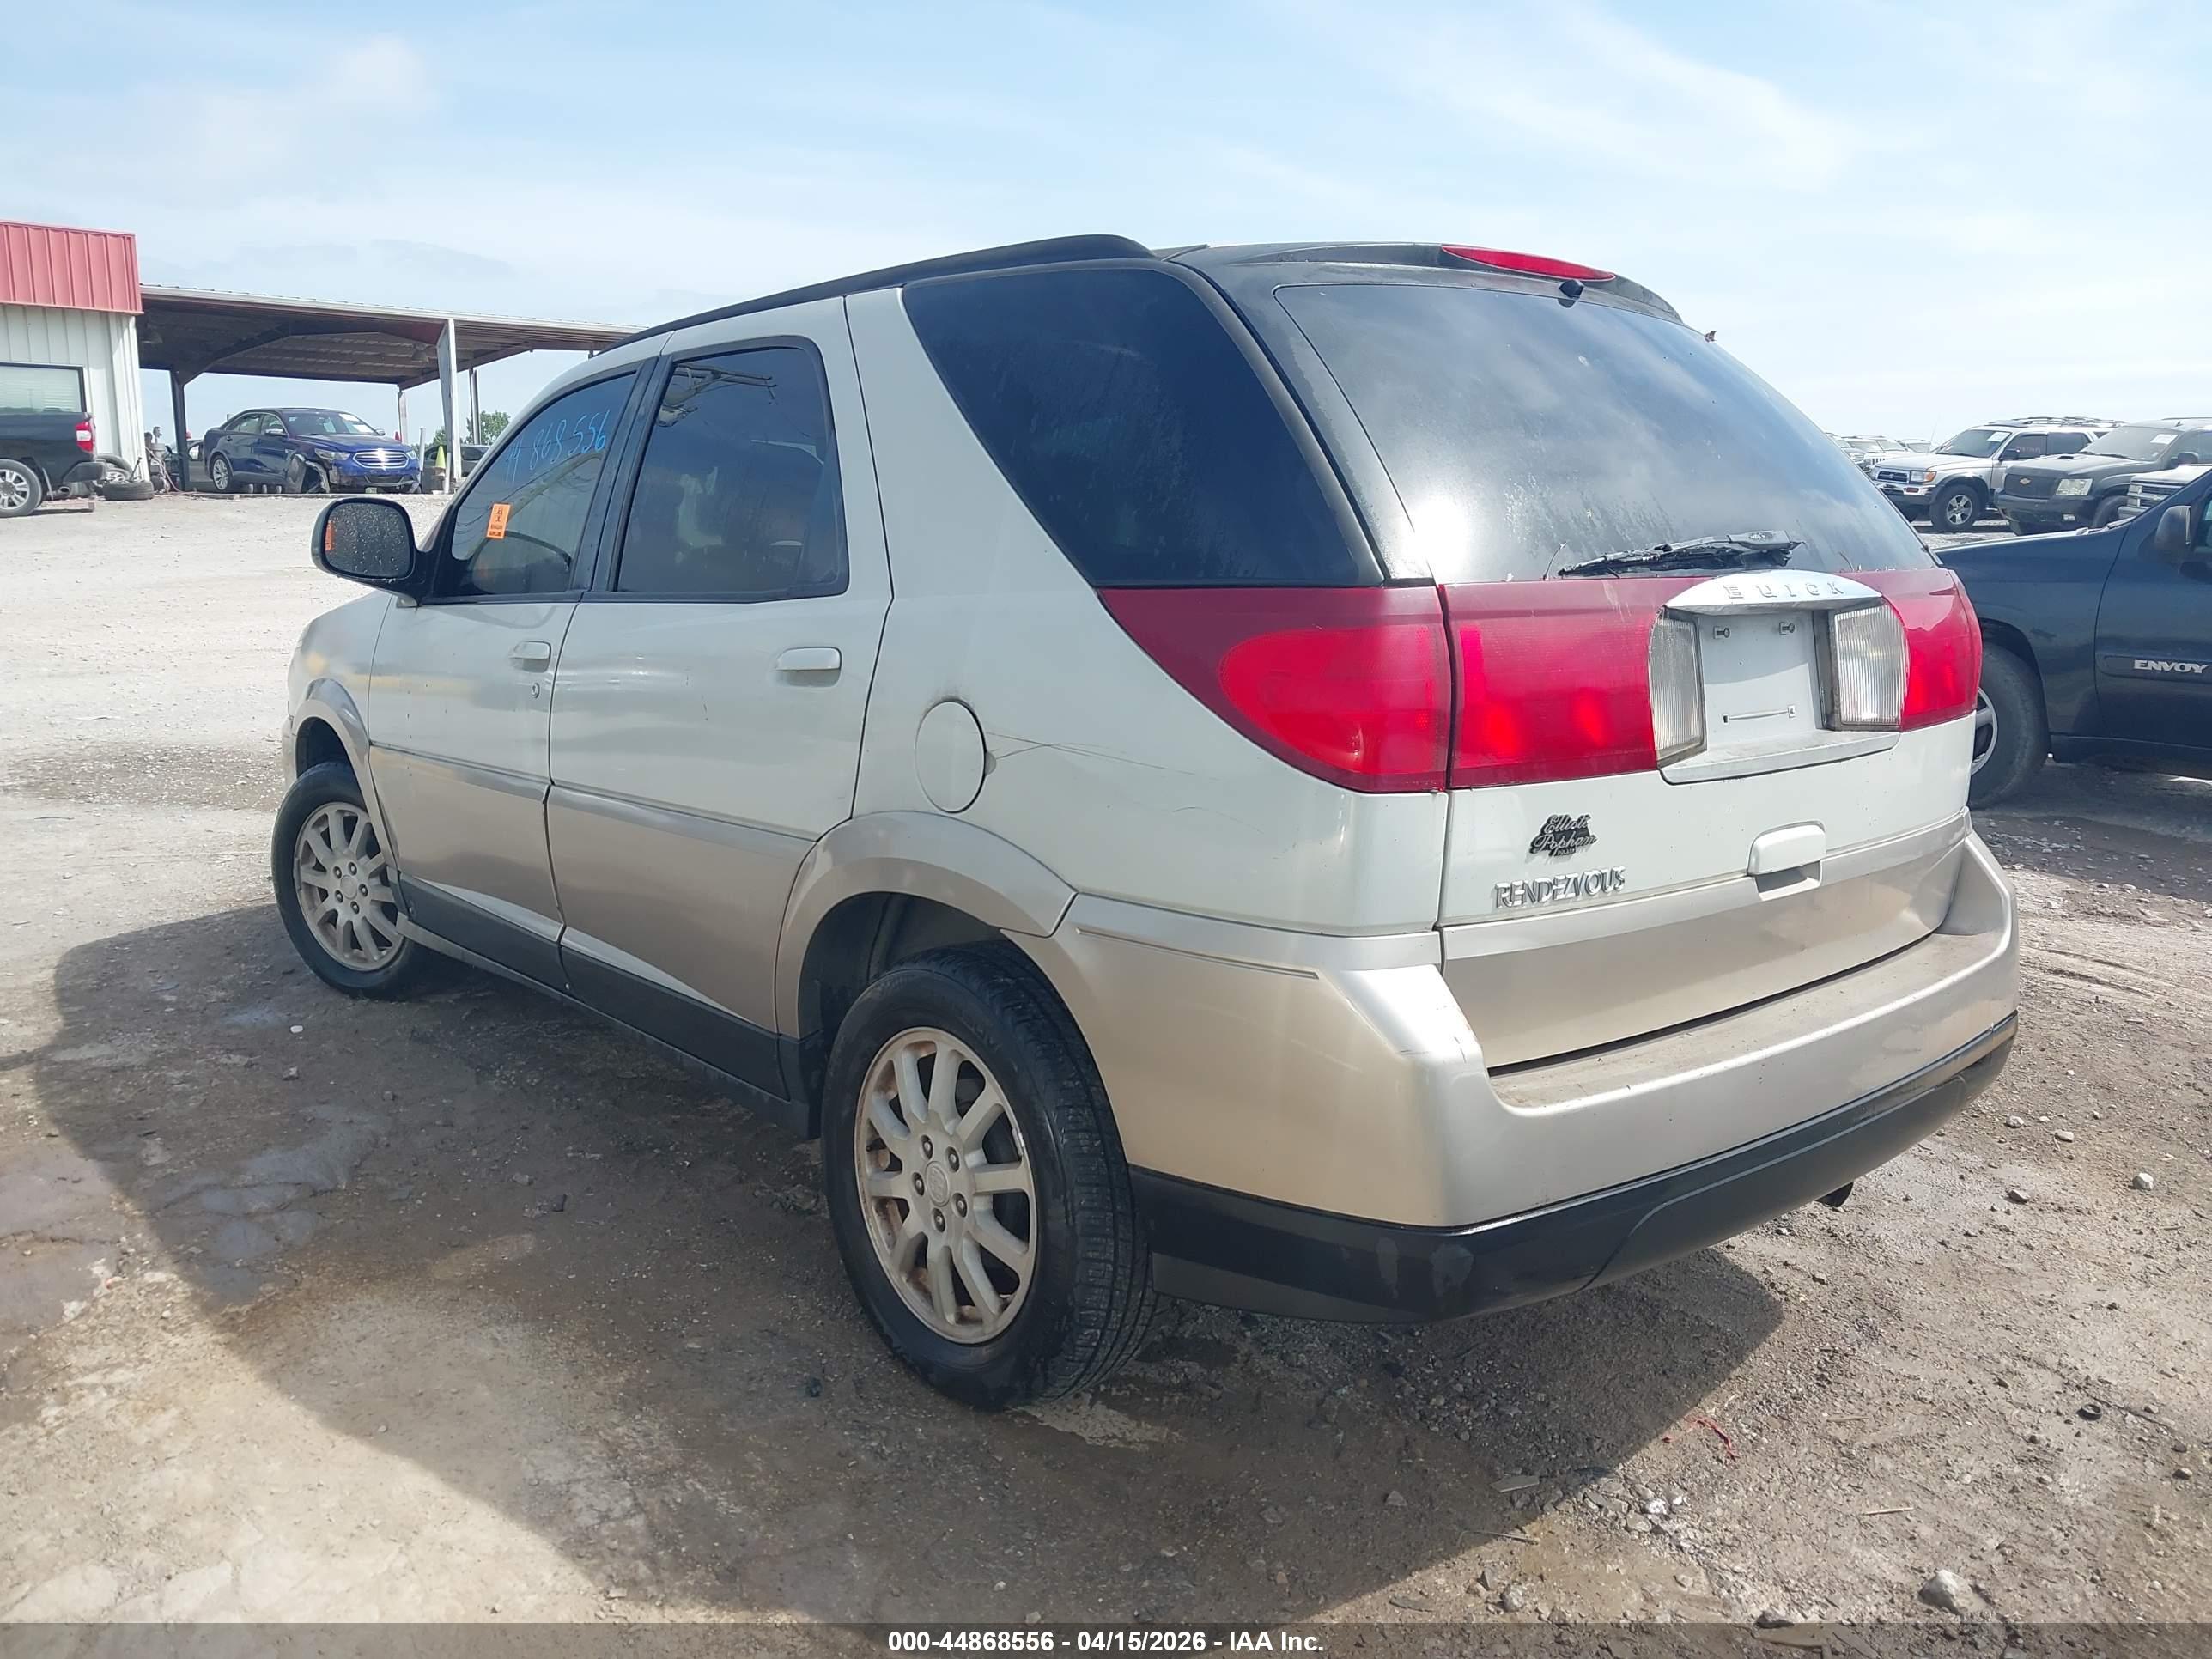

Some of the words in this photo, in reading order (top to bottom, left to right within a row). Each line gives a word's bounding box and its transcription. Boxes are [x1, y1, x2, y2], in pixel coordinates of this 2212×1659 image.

[1723, 581, 1844, 599] BUICK
[2134, 659, 2209, 674] ENVOY
[1529, 831, 1598, 856] Popham
[1495, 866, 1626, 908] RENDEZVOUS
